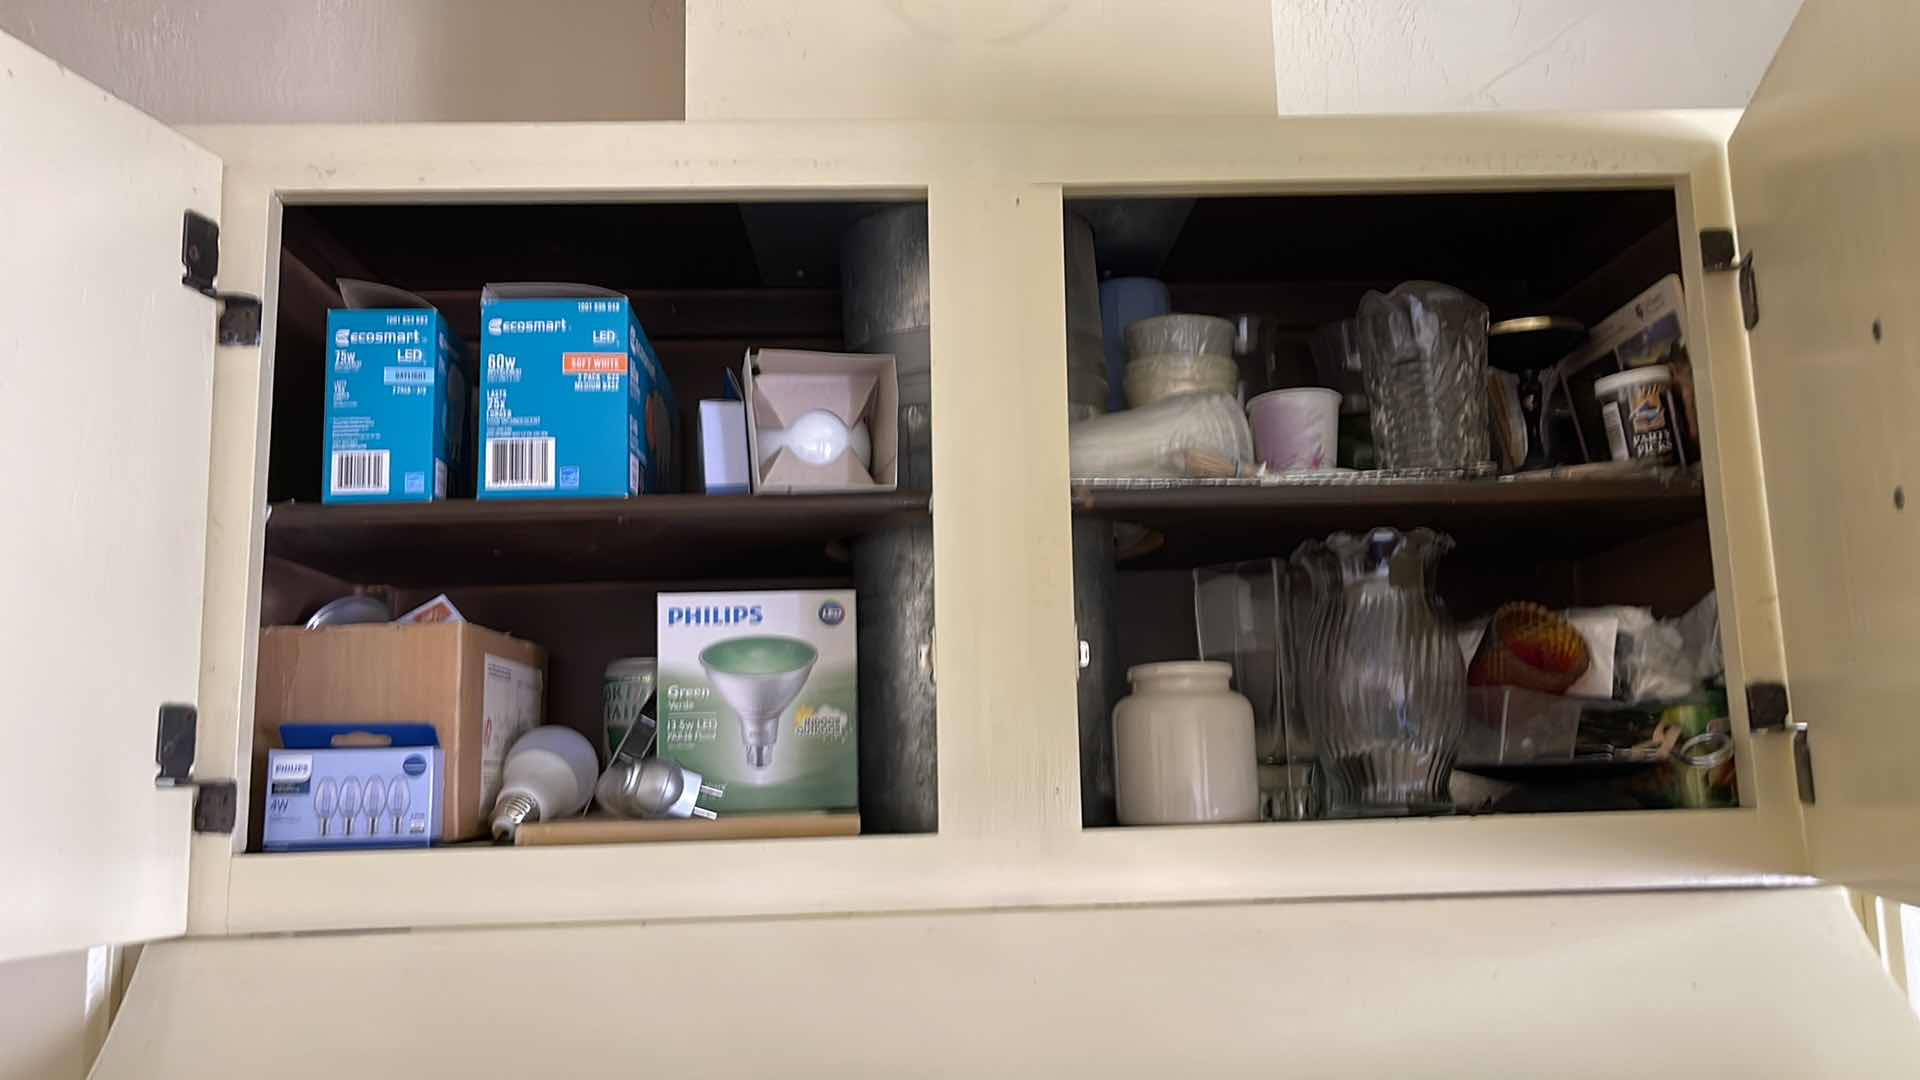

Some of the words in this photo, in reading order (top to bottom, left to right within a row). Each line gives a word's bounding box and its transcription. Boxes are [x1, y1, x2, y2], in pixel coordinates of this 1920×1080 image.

[592, 330, 616, 344] LED
[397, 348, 422, 362] LED
[571, 357, 592, 369] SOFT
[593, 357, 619, 369] WHITE
[668, 606, 763, 626] PHILIPS
[667, 685, 710, 698] Green
[275, 763, 309, 774] PHILIPS
